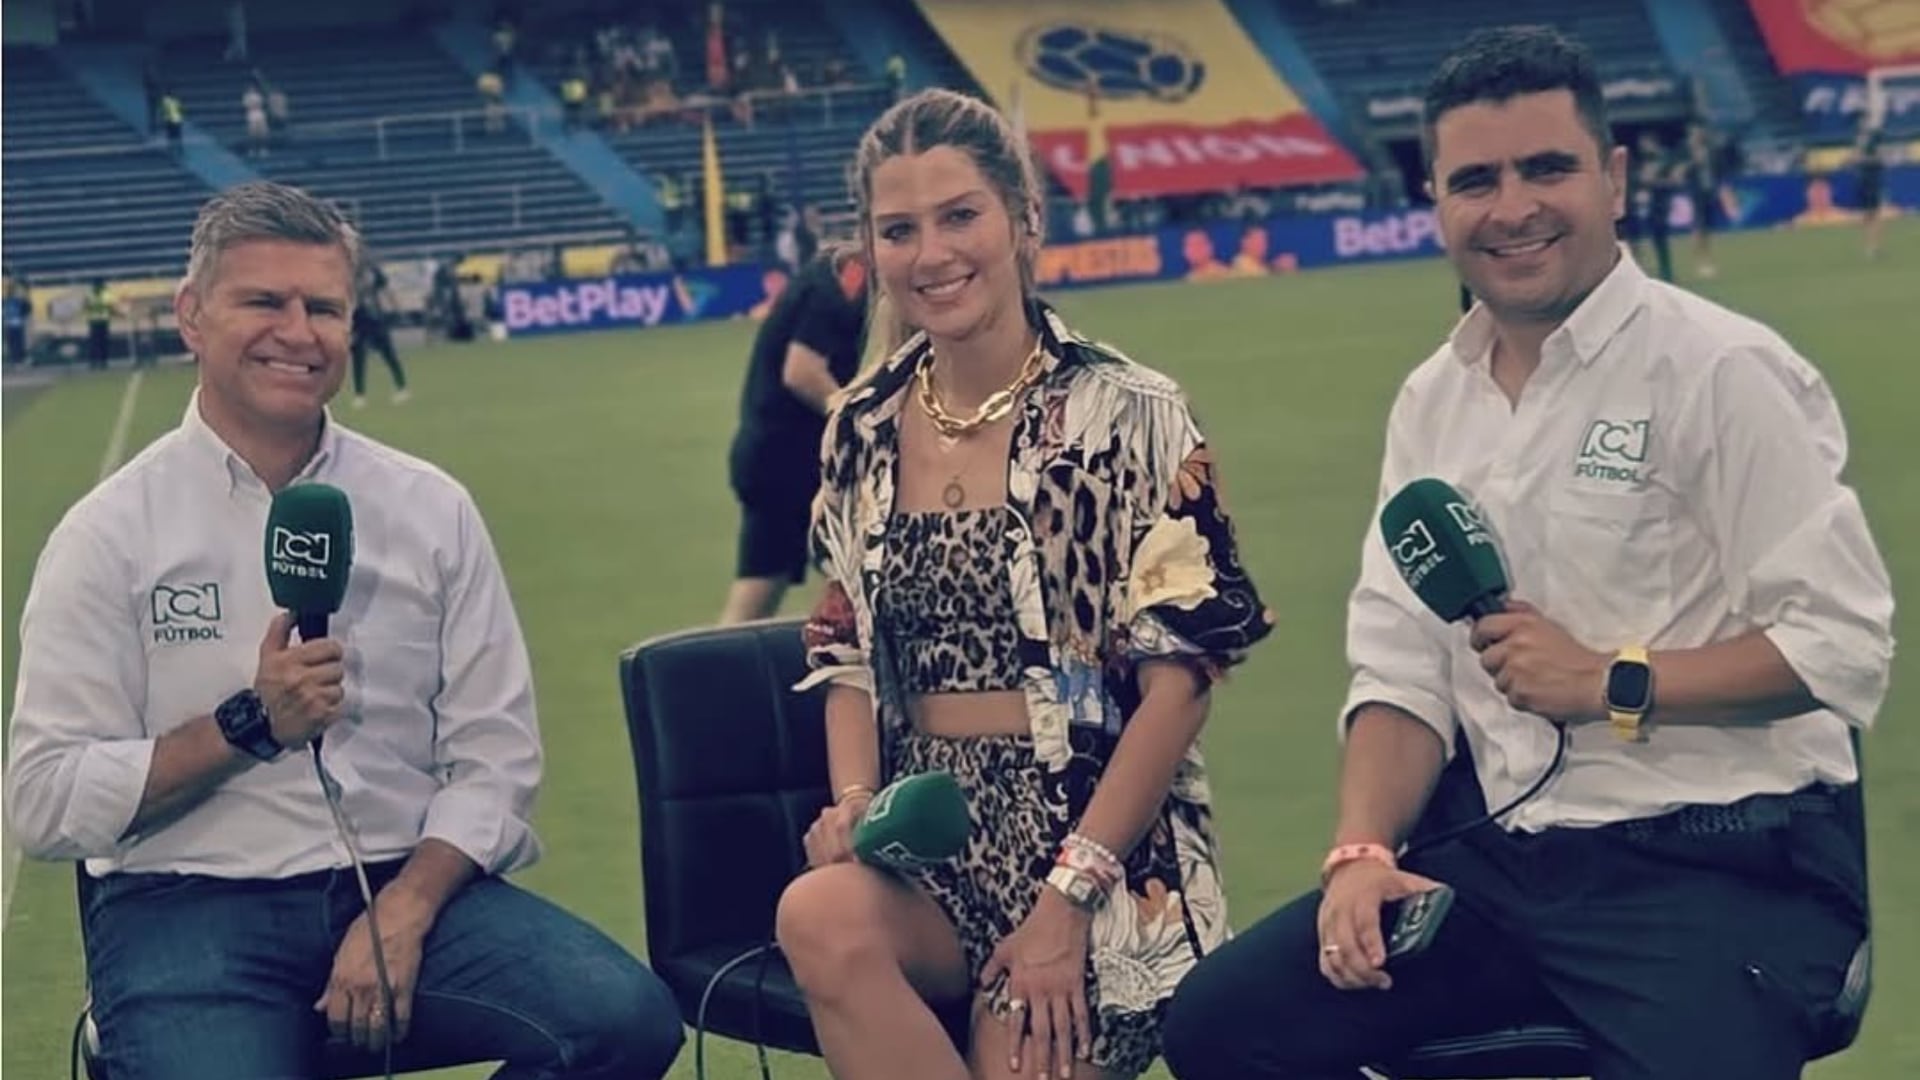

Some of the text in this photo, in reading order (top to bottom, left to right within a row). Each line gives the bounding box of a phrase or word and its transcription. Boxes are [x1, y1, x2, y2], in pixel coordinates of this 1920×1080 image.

[1334, 211, 1448, 256] BetP
[504, 279, 669, 328] BetPlay
[154, 624, 223, 642] FÚTBOL
